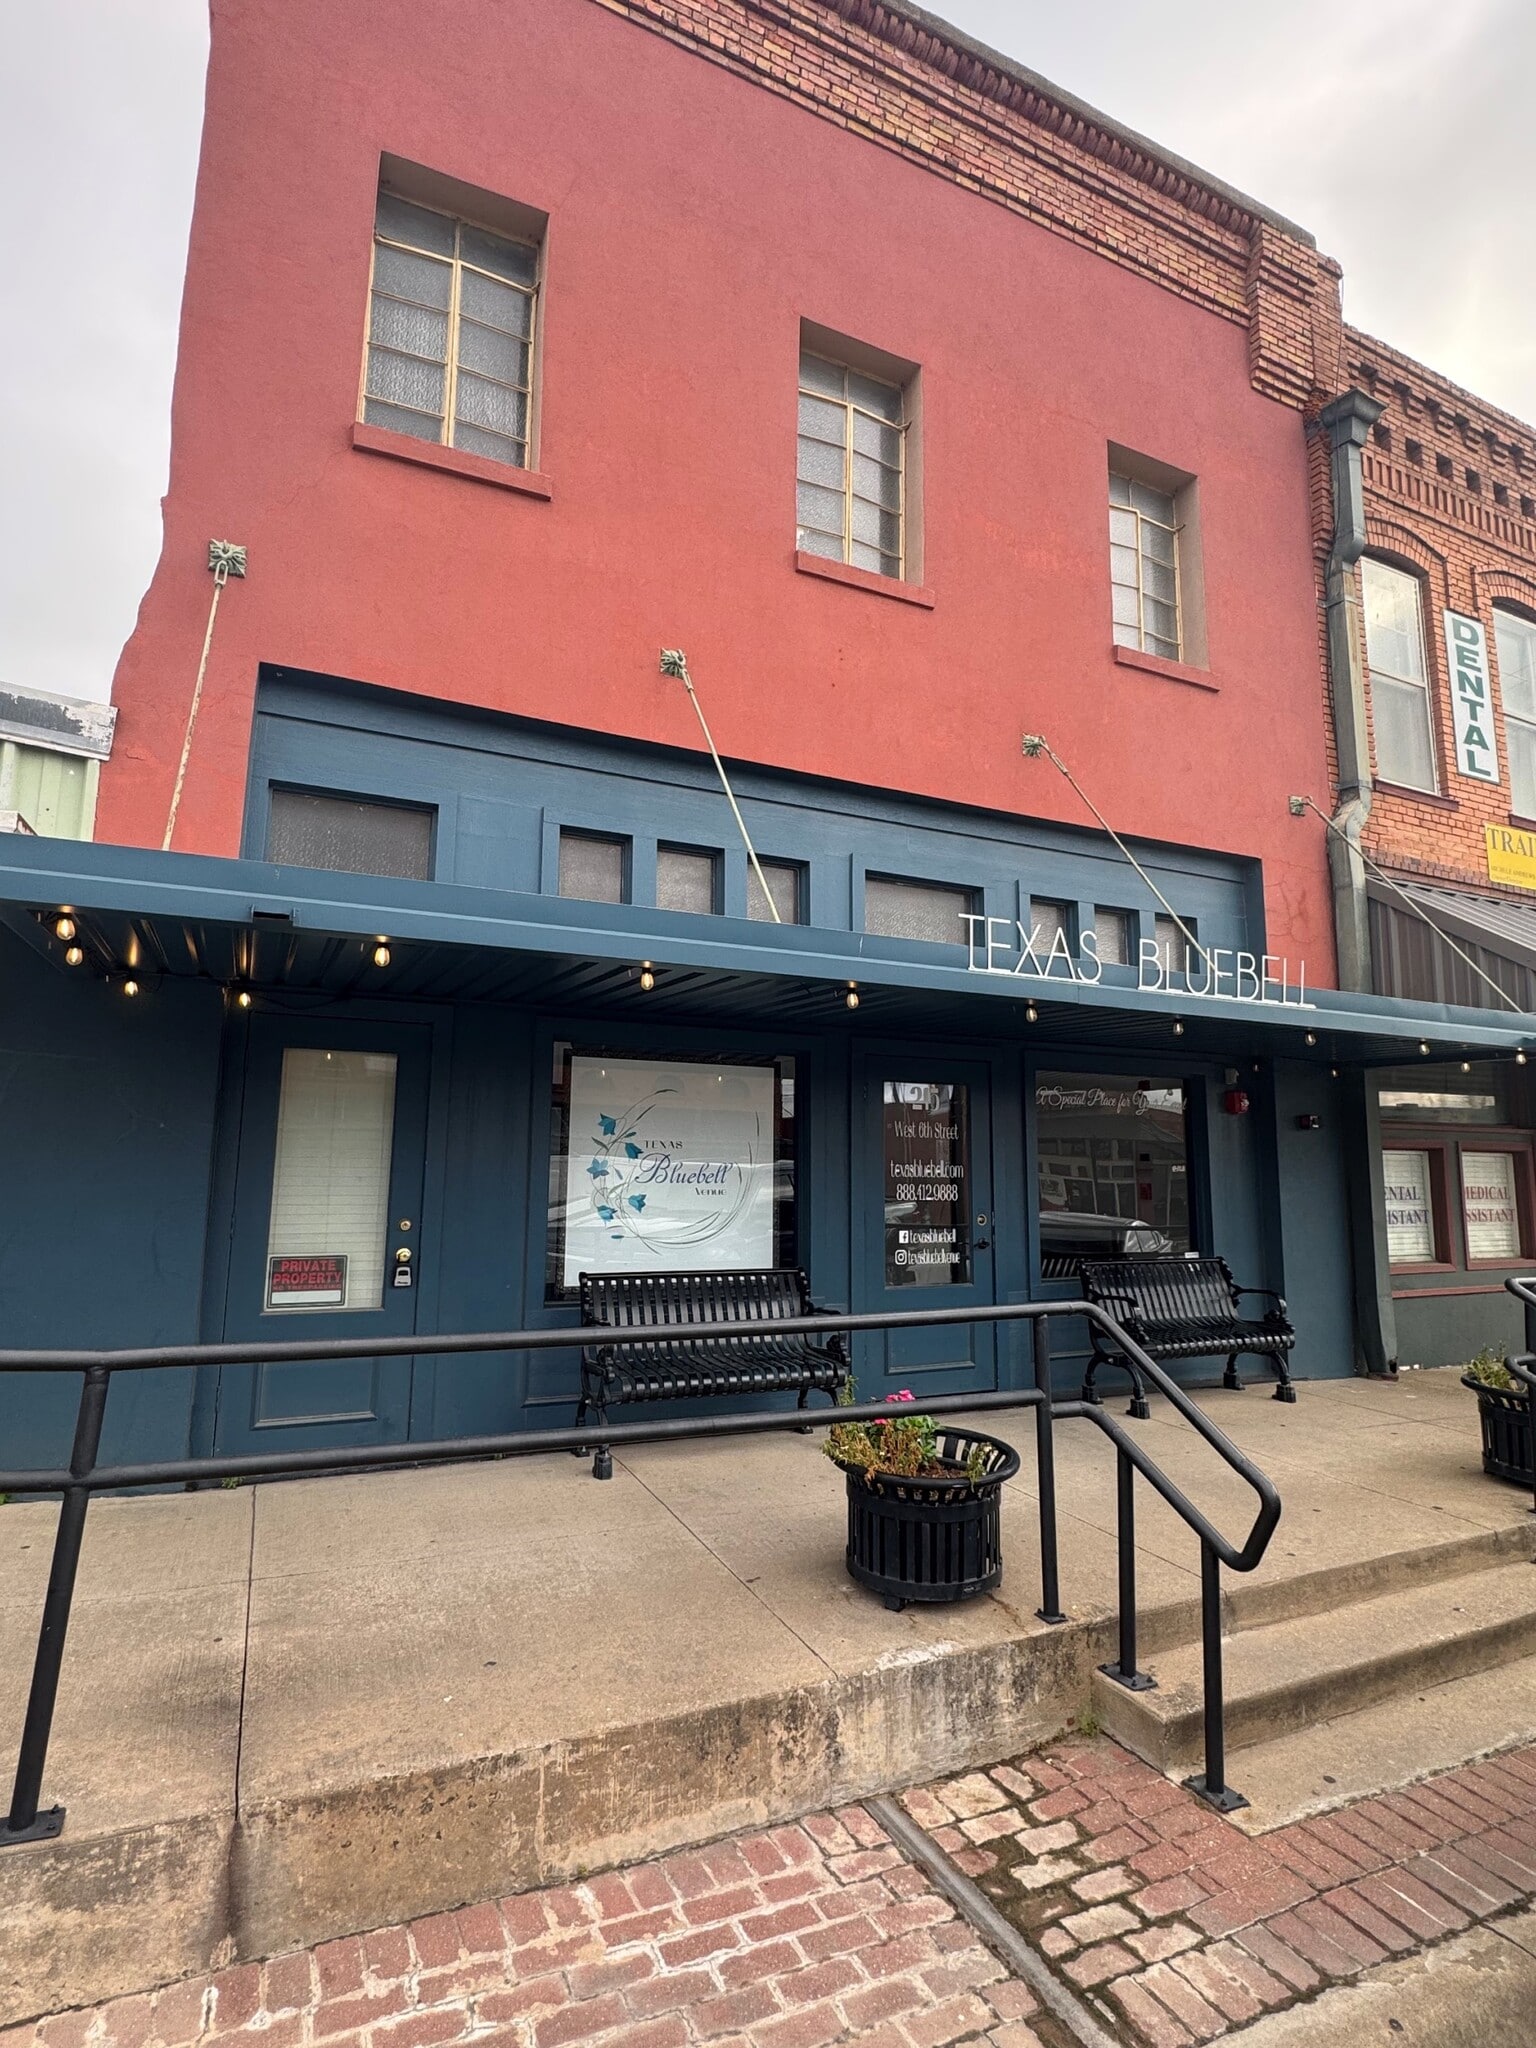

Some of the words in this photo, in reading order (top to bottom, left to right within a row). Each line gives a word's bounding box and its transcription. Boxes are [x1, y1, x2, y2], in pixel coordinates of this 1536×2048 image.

[1451, 617, 1491, 777] DENTAL
[1487, 827, 1536, 858] TRAI
[958, 913, 1102, 985] TEXAS
[1138, 938, 1316, 1009] BLUEBELL
[1048, 1086, 1087, 1110] Special
[1087, 1088, 1116, 1106] Place
[1116, 1093, 1131, 1114] for
[894, 1120, 917, 1138] West
[918, 1121, 933, 1138] 6th
[934, 1122, 960, 1140] Street
[644, 1139, 683, 1150] TEXAS
[634, 1152, 734, 1185] Bluebell
[890, 1158, 965, 1179] texasbluebell.com
[694, 1187, 728, 1196] Venue
[896, 1183, 959, 1202] 888.412.9888
[281, 1260, 337, 1272] PRIVATE
[272, 1272, 342, 1284] PROPERTY
